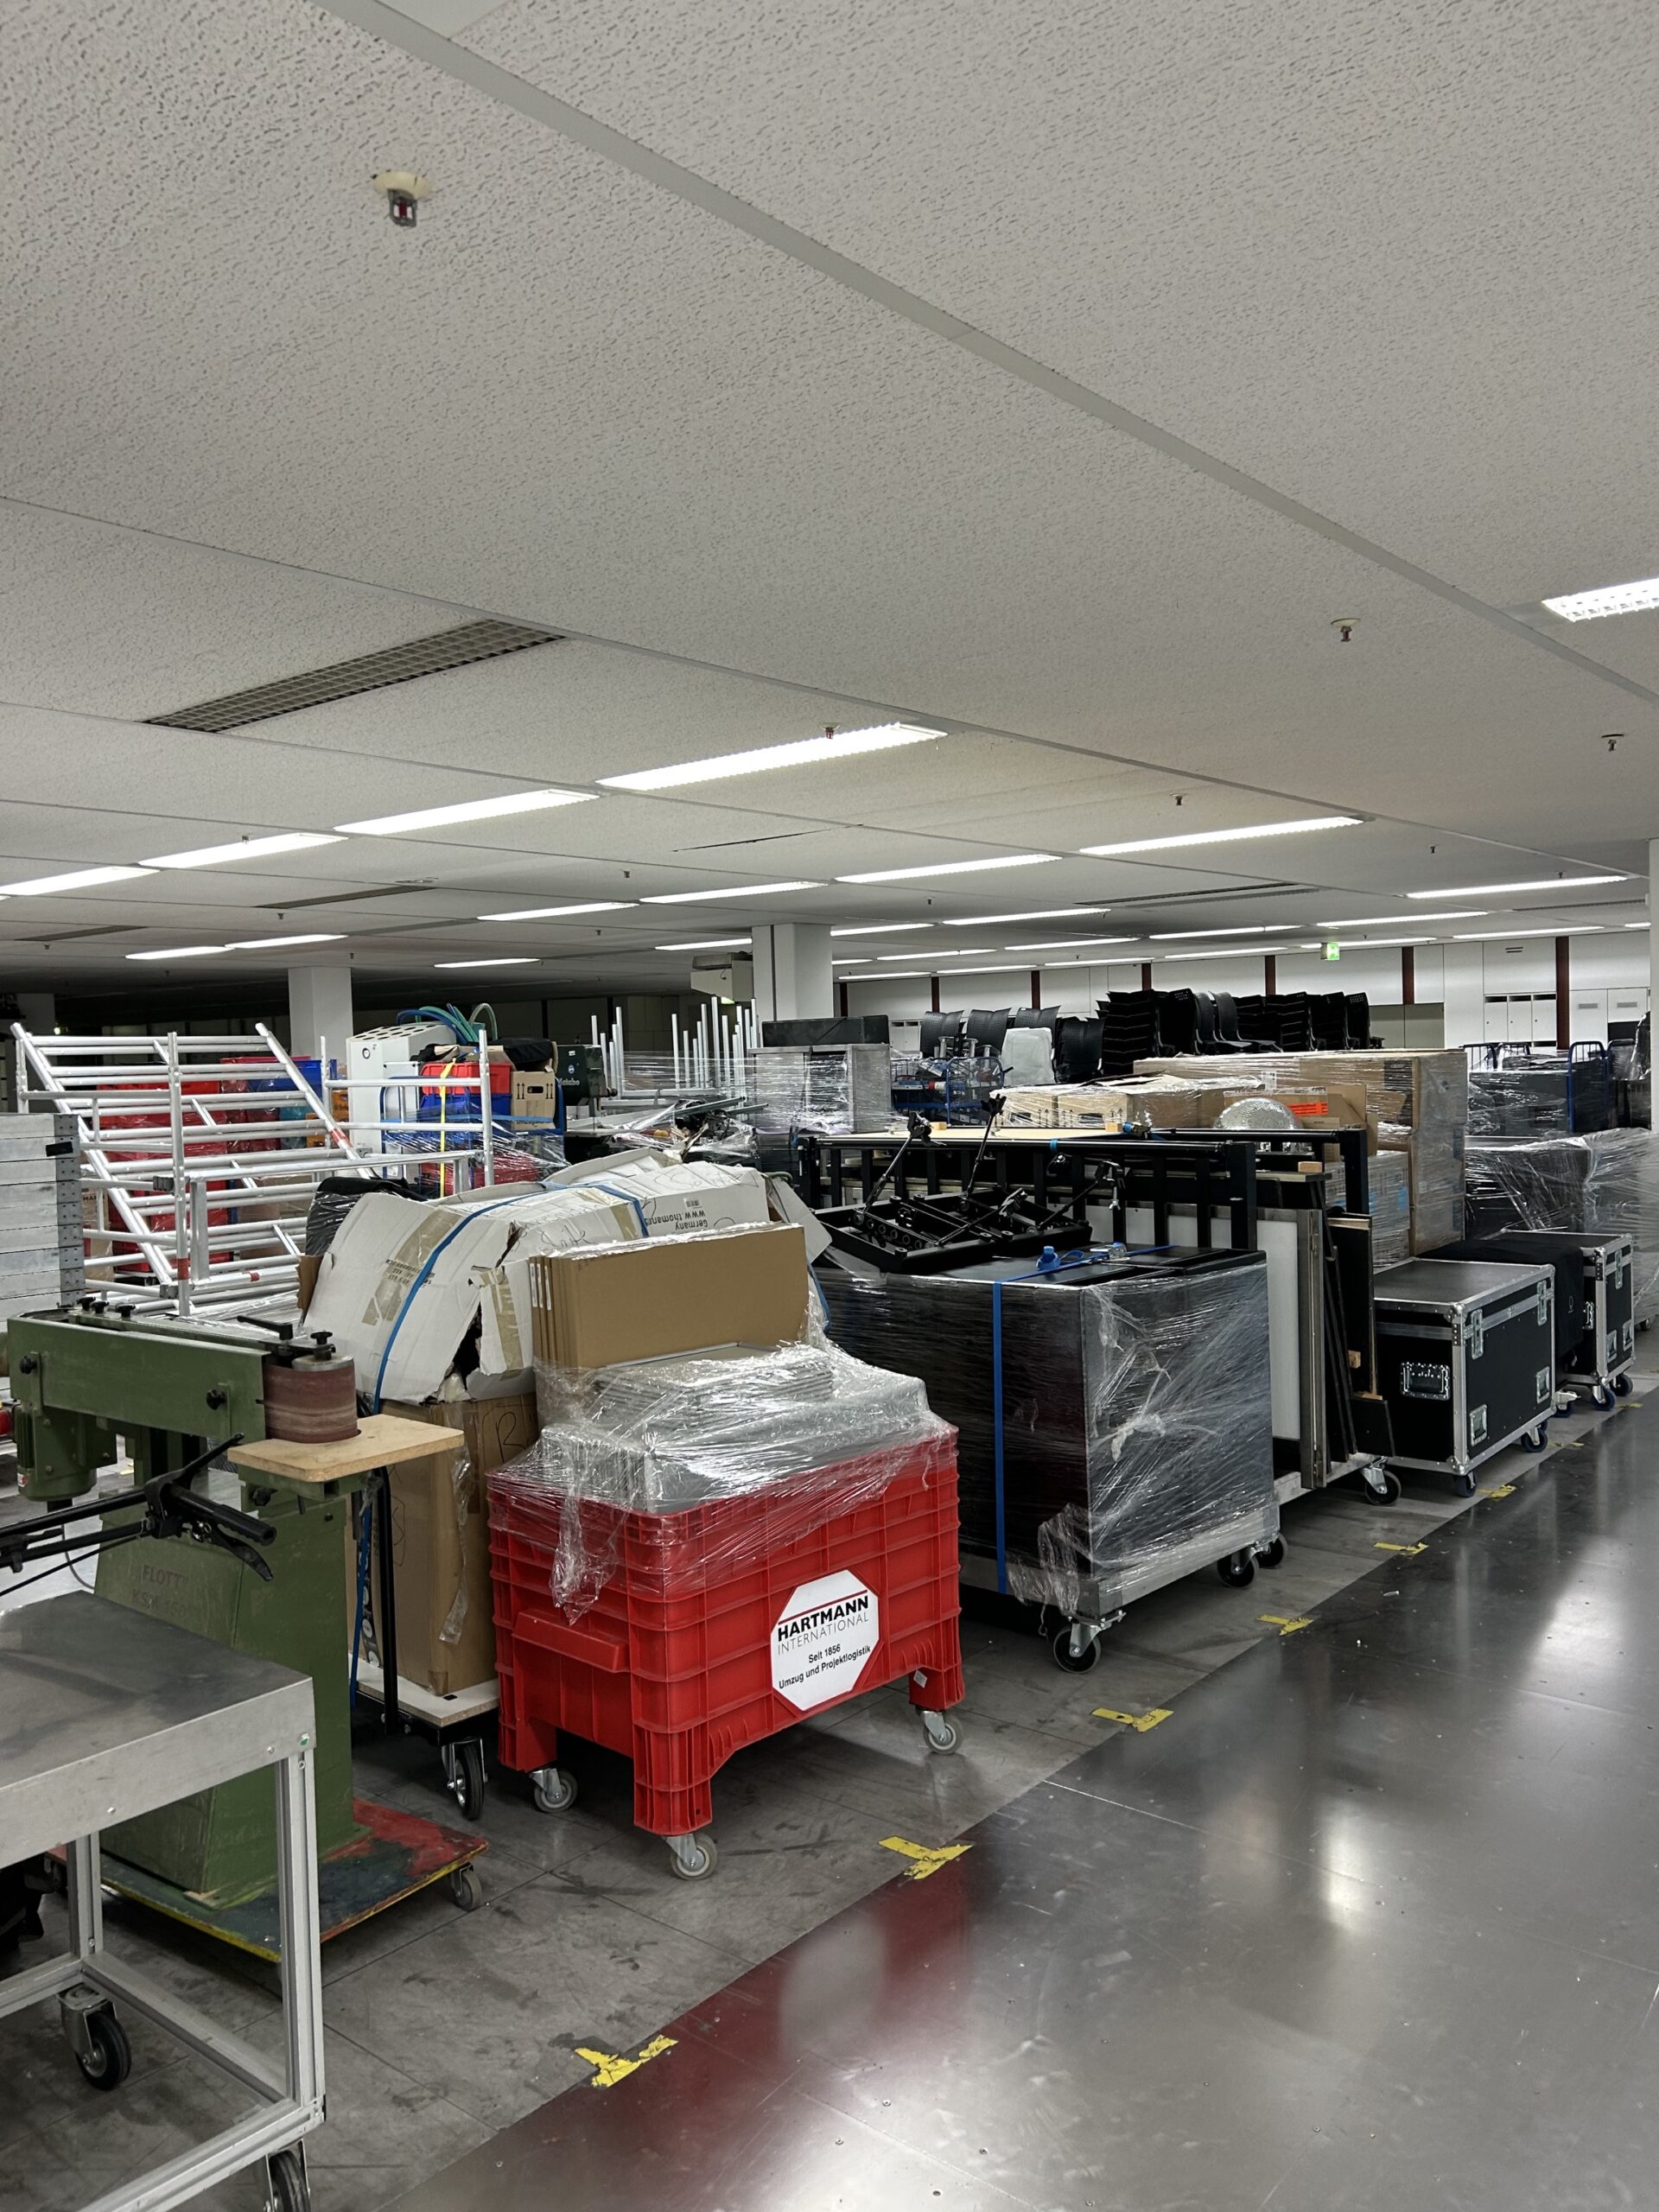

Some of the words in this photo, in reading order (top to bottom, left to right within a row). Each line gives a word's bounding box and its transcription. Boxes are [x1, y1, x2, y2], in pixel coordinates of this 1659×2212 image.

[676, 1219, 708, 1230] Germany
[778, 1595, 868, 1642] HARTMANN
[778, 1611, 869, 1656] INTERNATIONAL
[779, 1673, 804, 1689] Umzug
[805, 1665, 820, 1678] und
[821, 1645, 871, 1671] Projektlogistik
[809, 1651, 823, 1663] Seit
[824, 1643, 841, 1656] 1856
